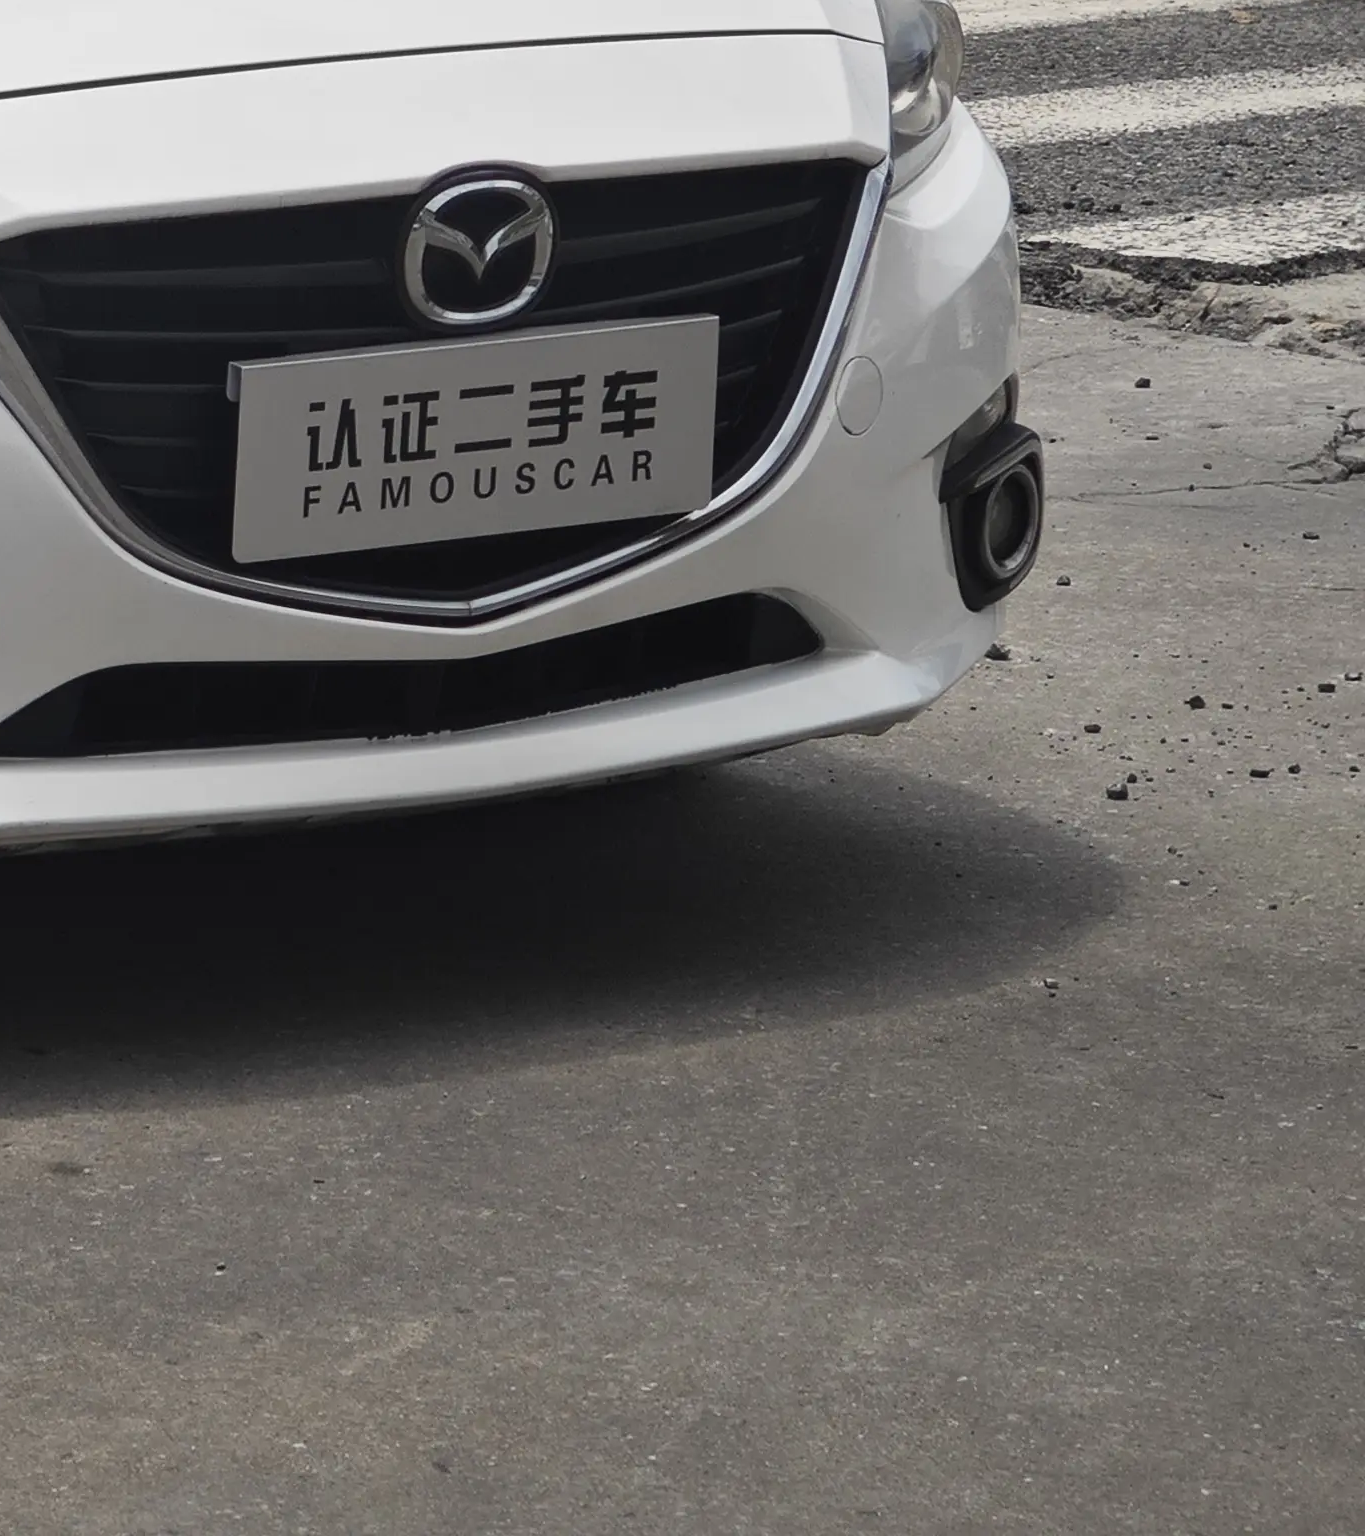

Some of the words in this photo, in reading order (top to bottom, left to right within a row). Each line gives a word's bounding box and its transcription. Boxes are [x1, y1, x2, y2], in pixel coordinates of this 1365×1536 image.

[306, 370, 659, 472] 认证二手车
[302, 449, 654, 519] FAMOUSCAR
